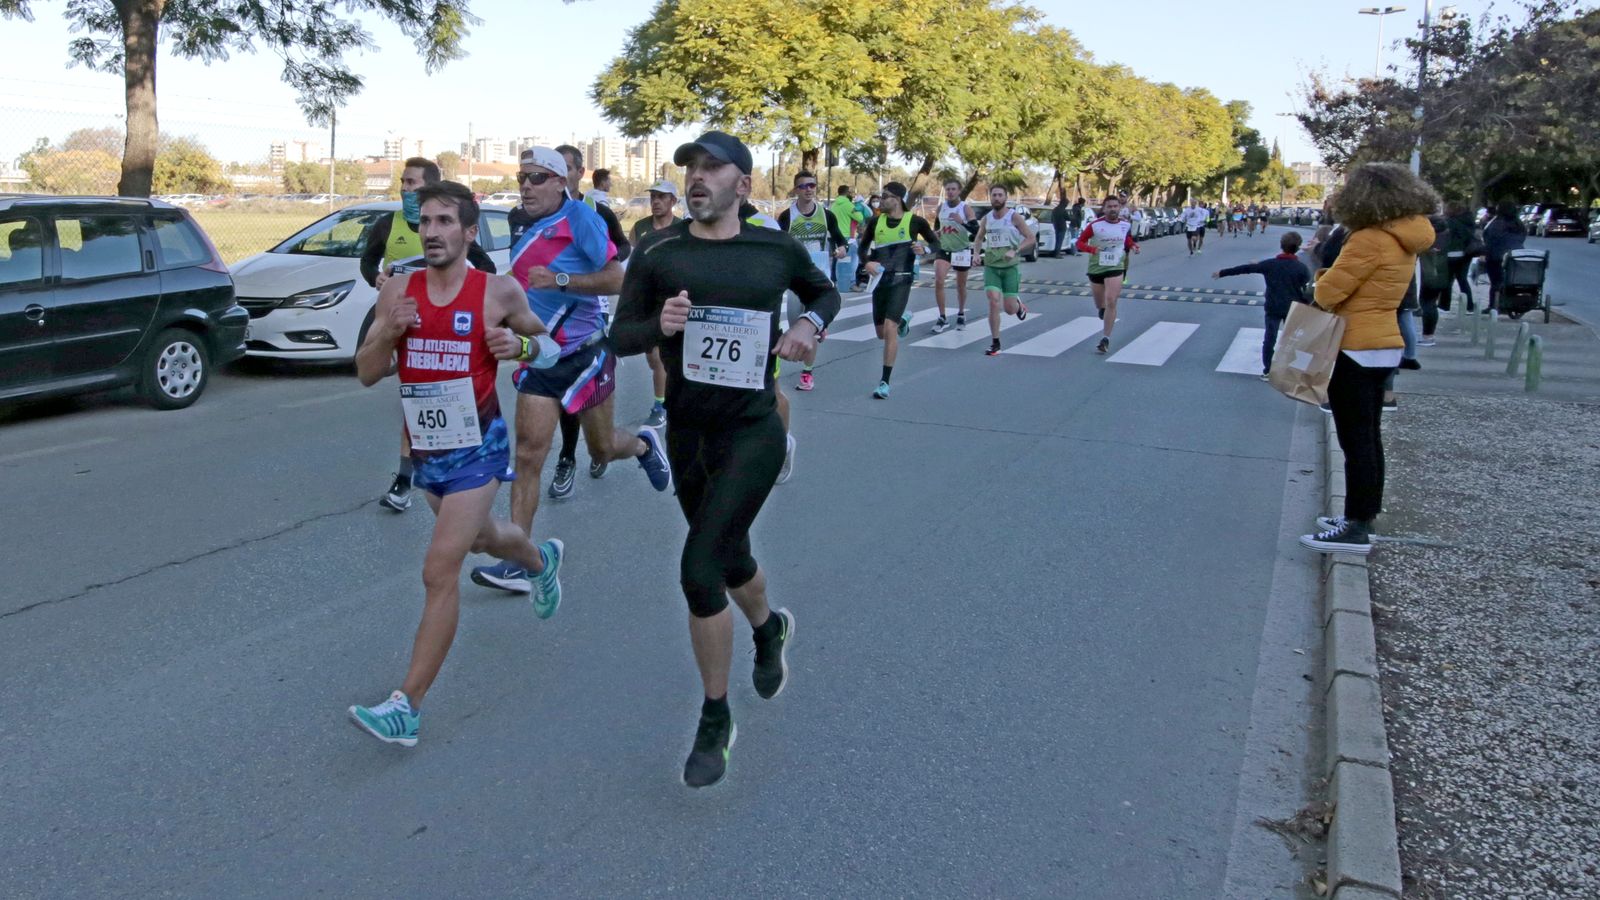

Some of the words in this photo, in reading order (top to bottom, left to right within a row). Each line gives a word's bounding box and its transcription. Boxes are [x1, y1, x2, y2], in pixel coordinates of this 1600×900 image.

[721, 326, 758, 335] ALBERTO
[407, 338, 424, 351] CLUB
[424, 338, 472, 354] ATLETISMO
[701, 337, 741, 362] 276
[406, 351, 470, 372] TREBUJENA
[417, 409, 447, 429] 450
